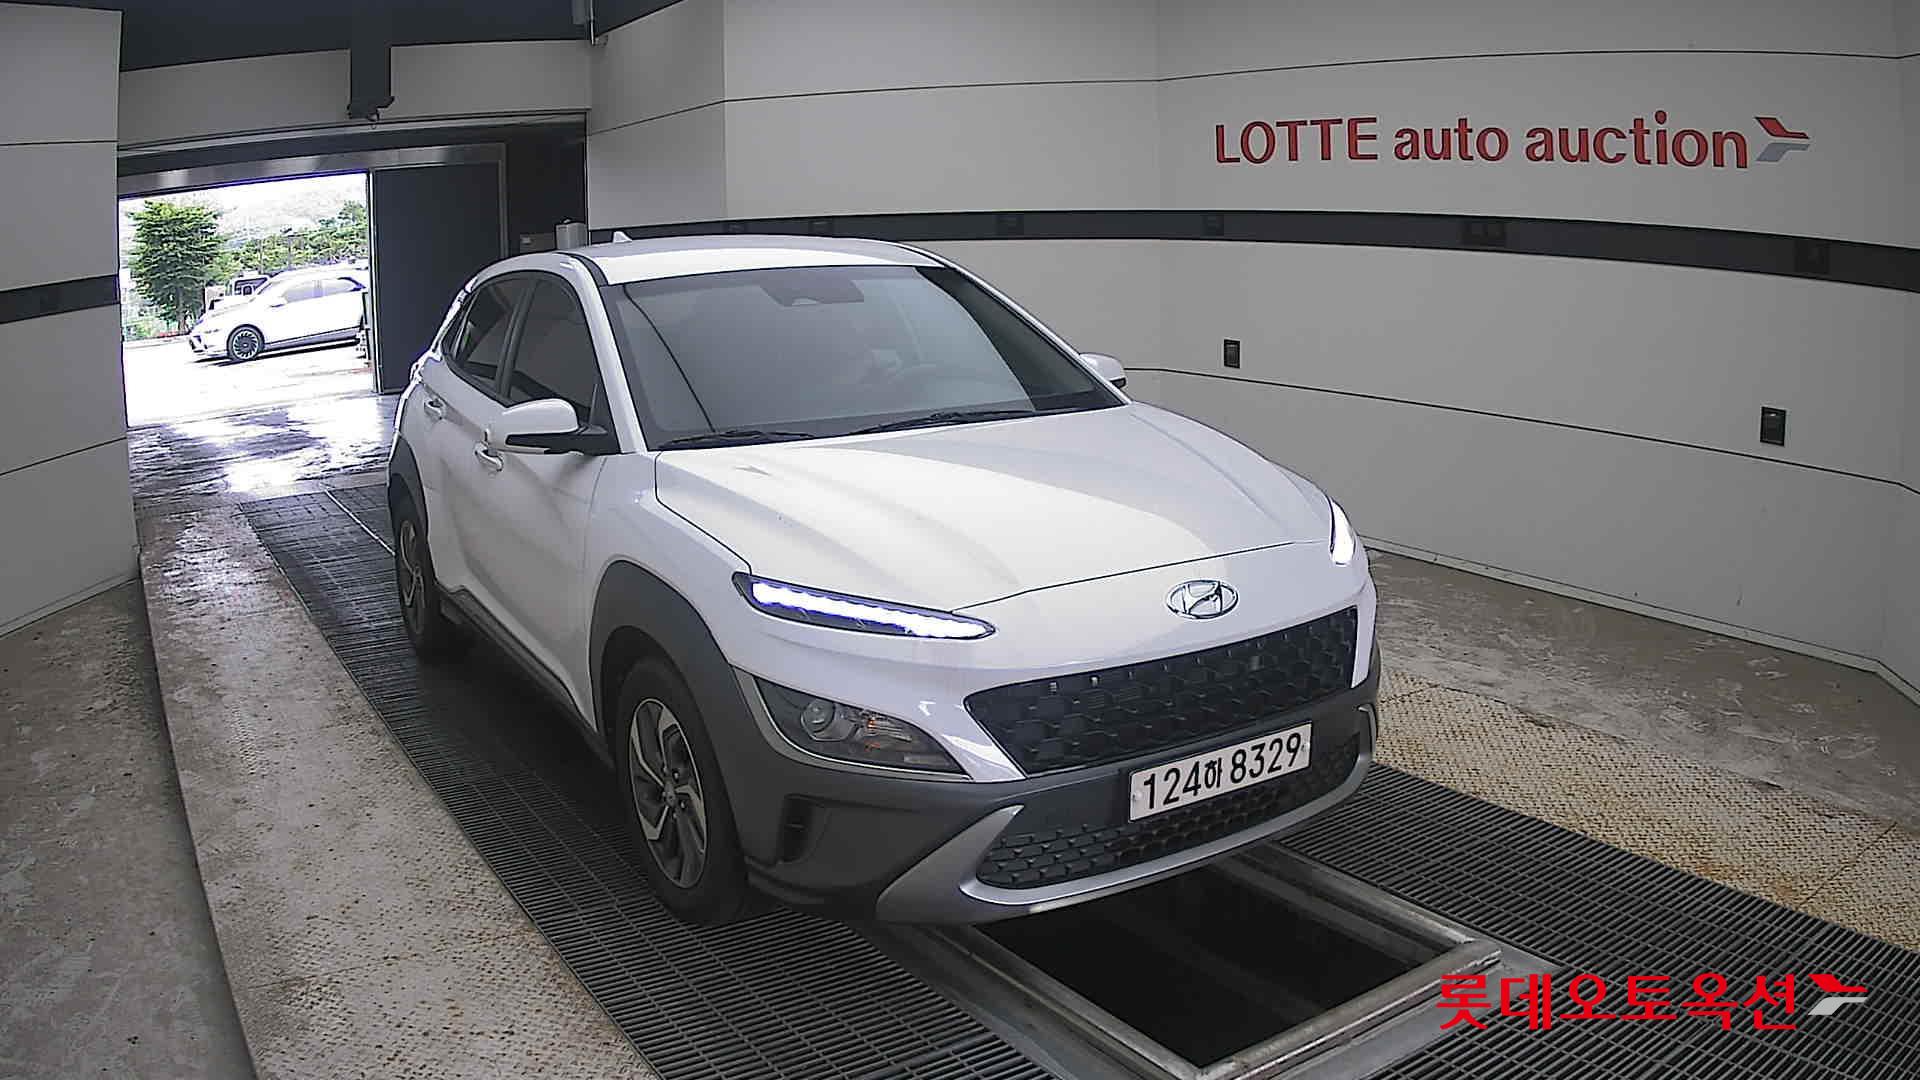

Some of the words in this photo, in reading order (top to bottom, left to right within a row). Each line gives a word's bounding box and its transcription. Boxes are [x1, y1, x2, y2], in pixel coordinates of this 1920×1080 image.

[1215, 117, 1378, 164] LOTTE
[1394, 117, 1508, 162] auto
[1525, 110, 1749, 169] auction
[1143, 758, 1223, 810] 124하
[1230, 732, 1301, 784] 8329
